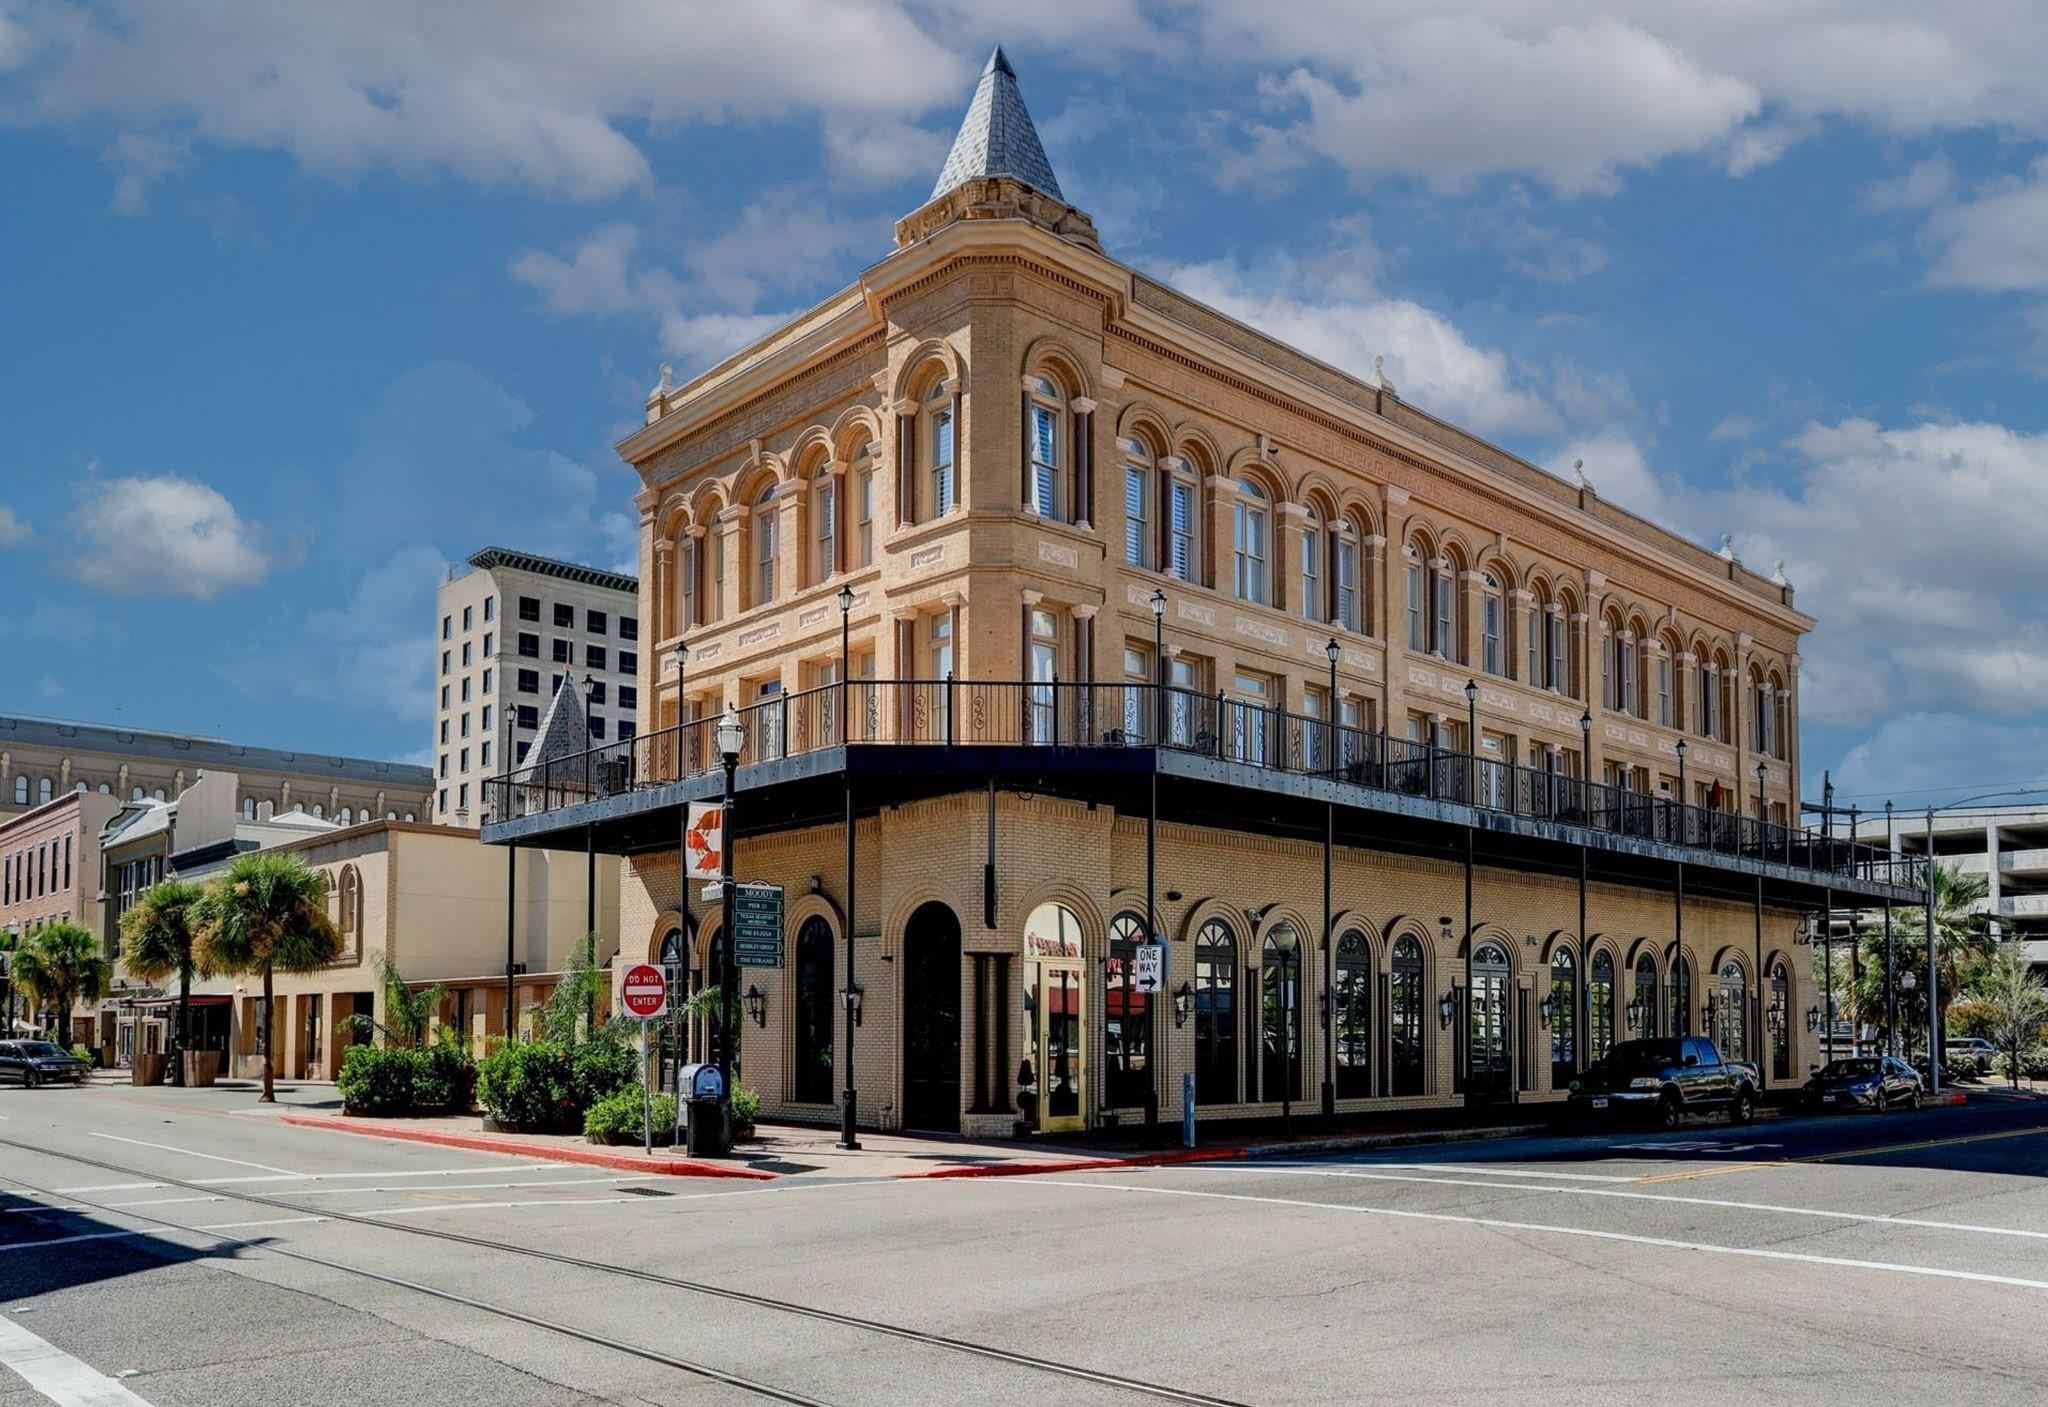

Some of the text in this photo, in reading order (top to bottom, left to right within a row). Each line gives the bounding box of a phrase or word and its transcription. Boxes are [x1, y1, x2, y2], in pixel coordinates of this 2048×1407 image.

[745, 889, 773, 898] MOODY
[1140, 949, 1158, 961] ONE
[752, 957, 775, 965] STRAND
[1139, 962, 1158, 973] WAY
[629, 975, 659, 984] DO NOT
[632, 997, 657, 1006] ENTER
